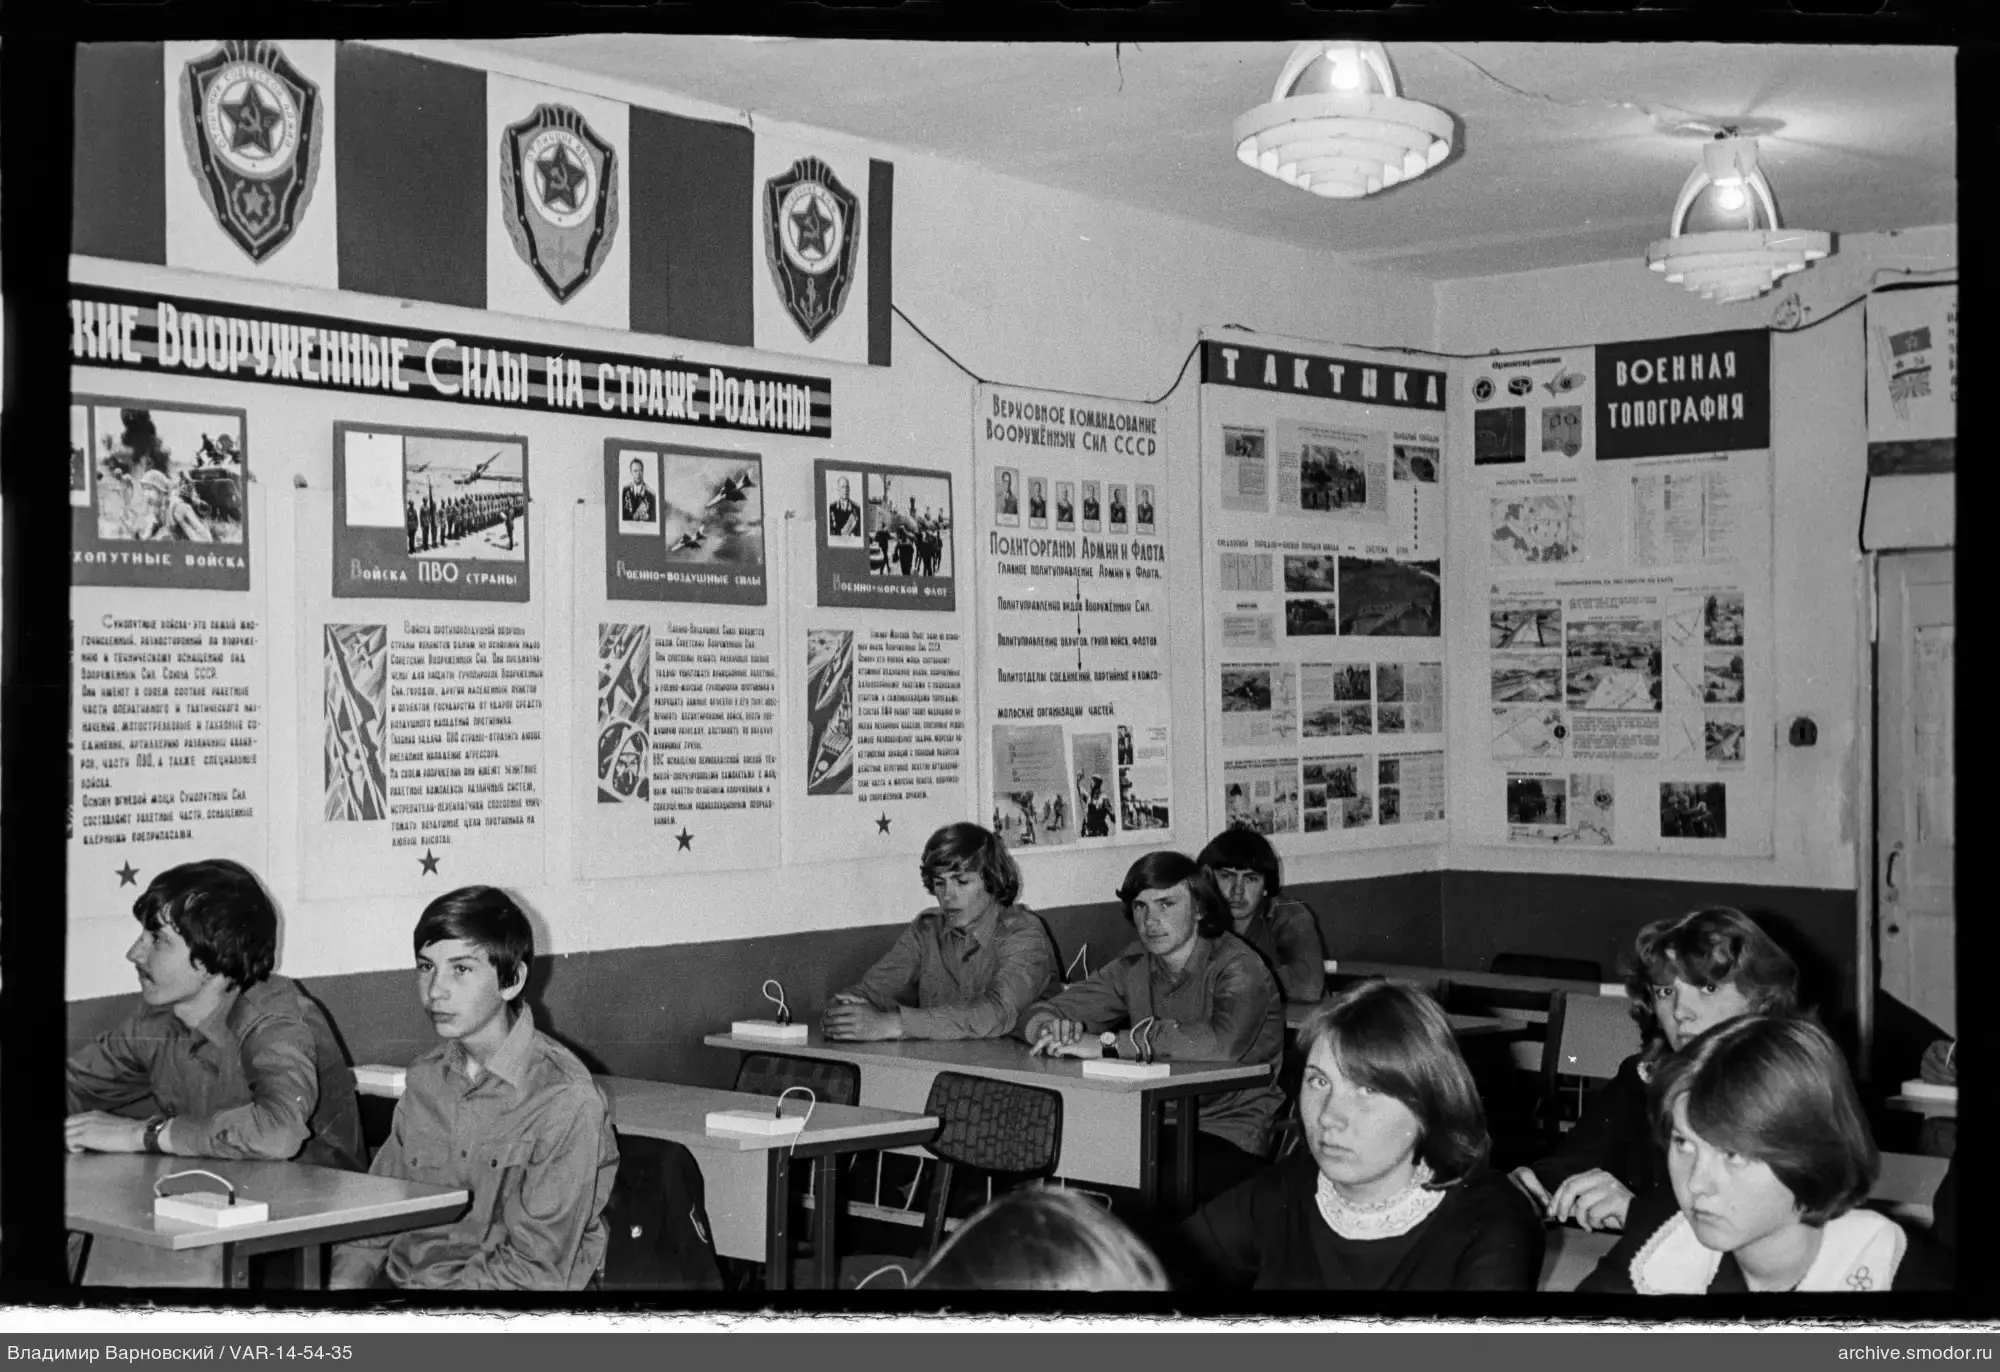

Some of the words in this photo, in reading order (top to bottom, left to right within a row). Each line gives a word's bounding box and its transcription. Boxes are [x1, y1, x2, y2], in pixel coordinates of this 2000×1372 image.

[157, 301, 410, 391] ВООРУЖЕННЫЕ
[425, 338, 528, 403] СИЛЫ
[546, 354, 584, 409] НА
[597, 362, 700, 420] СТРАЖЕ
[708, 367, 811, 431] РОДИНЫ
[1222, 347, 1438, 404] ТАКТИКА
[1616, 351, 1737, 387] ВОЕННАЯ
[992, 395, 1065, 425] ВЕРХОВНОЕ
[1069, 407, 1157, 437] КОМАНДОВАНИЕ
[1608, 393, 1744, 429] ТОПОГРАФИЯ
[986, 418, 1076, 449] ВООРУЖЁННЫХ
[1082, 431, 1107, 453] СИЛ
[1114, 434, 1156, 458] СССР
[72, 551, 172, 567] ХОПУТНЫЕ
[185, 552, 245, 569] ВОЙСКА
[989, 531, 1076, 559] ПОЛИТОРГАНЫ
[1081, 538, 1119, 561] АРМИИ
[1120, 543, 1128, 561] И
[1131, 542, 1165, 562] ФЛОТА
[351, 559, 408, 582] ВОЙСКА
[418, 562, 459, 583] ПВО
[466, 573, 518, 587] СТРАНЫ
[616, 559, 730, 586] ВОЕННО-ВОЗДУШНЫЕ
[735, 575, 762, 586] СИЛЫ
[832, 573, 919, 596] ВОЕННО-МОРСКОЙ
[924, 586, 948, 597] ФЛОТ
[997, 562, 1027, 576] ГЛАВНОЕ
[1030, 564, 1093, 578] ПОЛИТУПРАВЛЕНИЕ
[1098, 566, 1124, 579] АРМИИ
[1125, 569, 1131, 579] И
[997, 707, 1034, 719] МОЛЬСКИЕ
[1036, 706, 1084, 719] ОРГАНИЗАЦИИ
